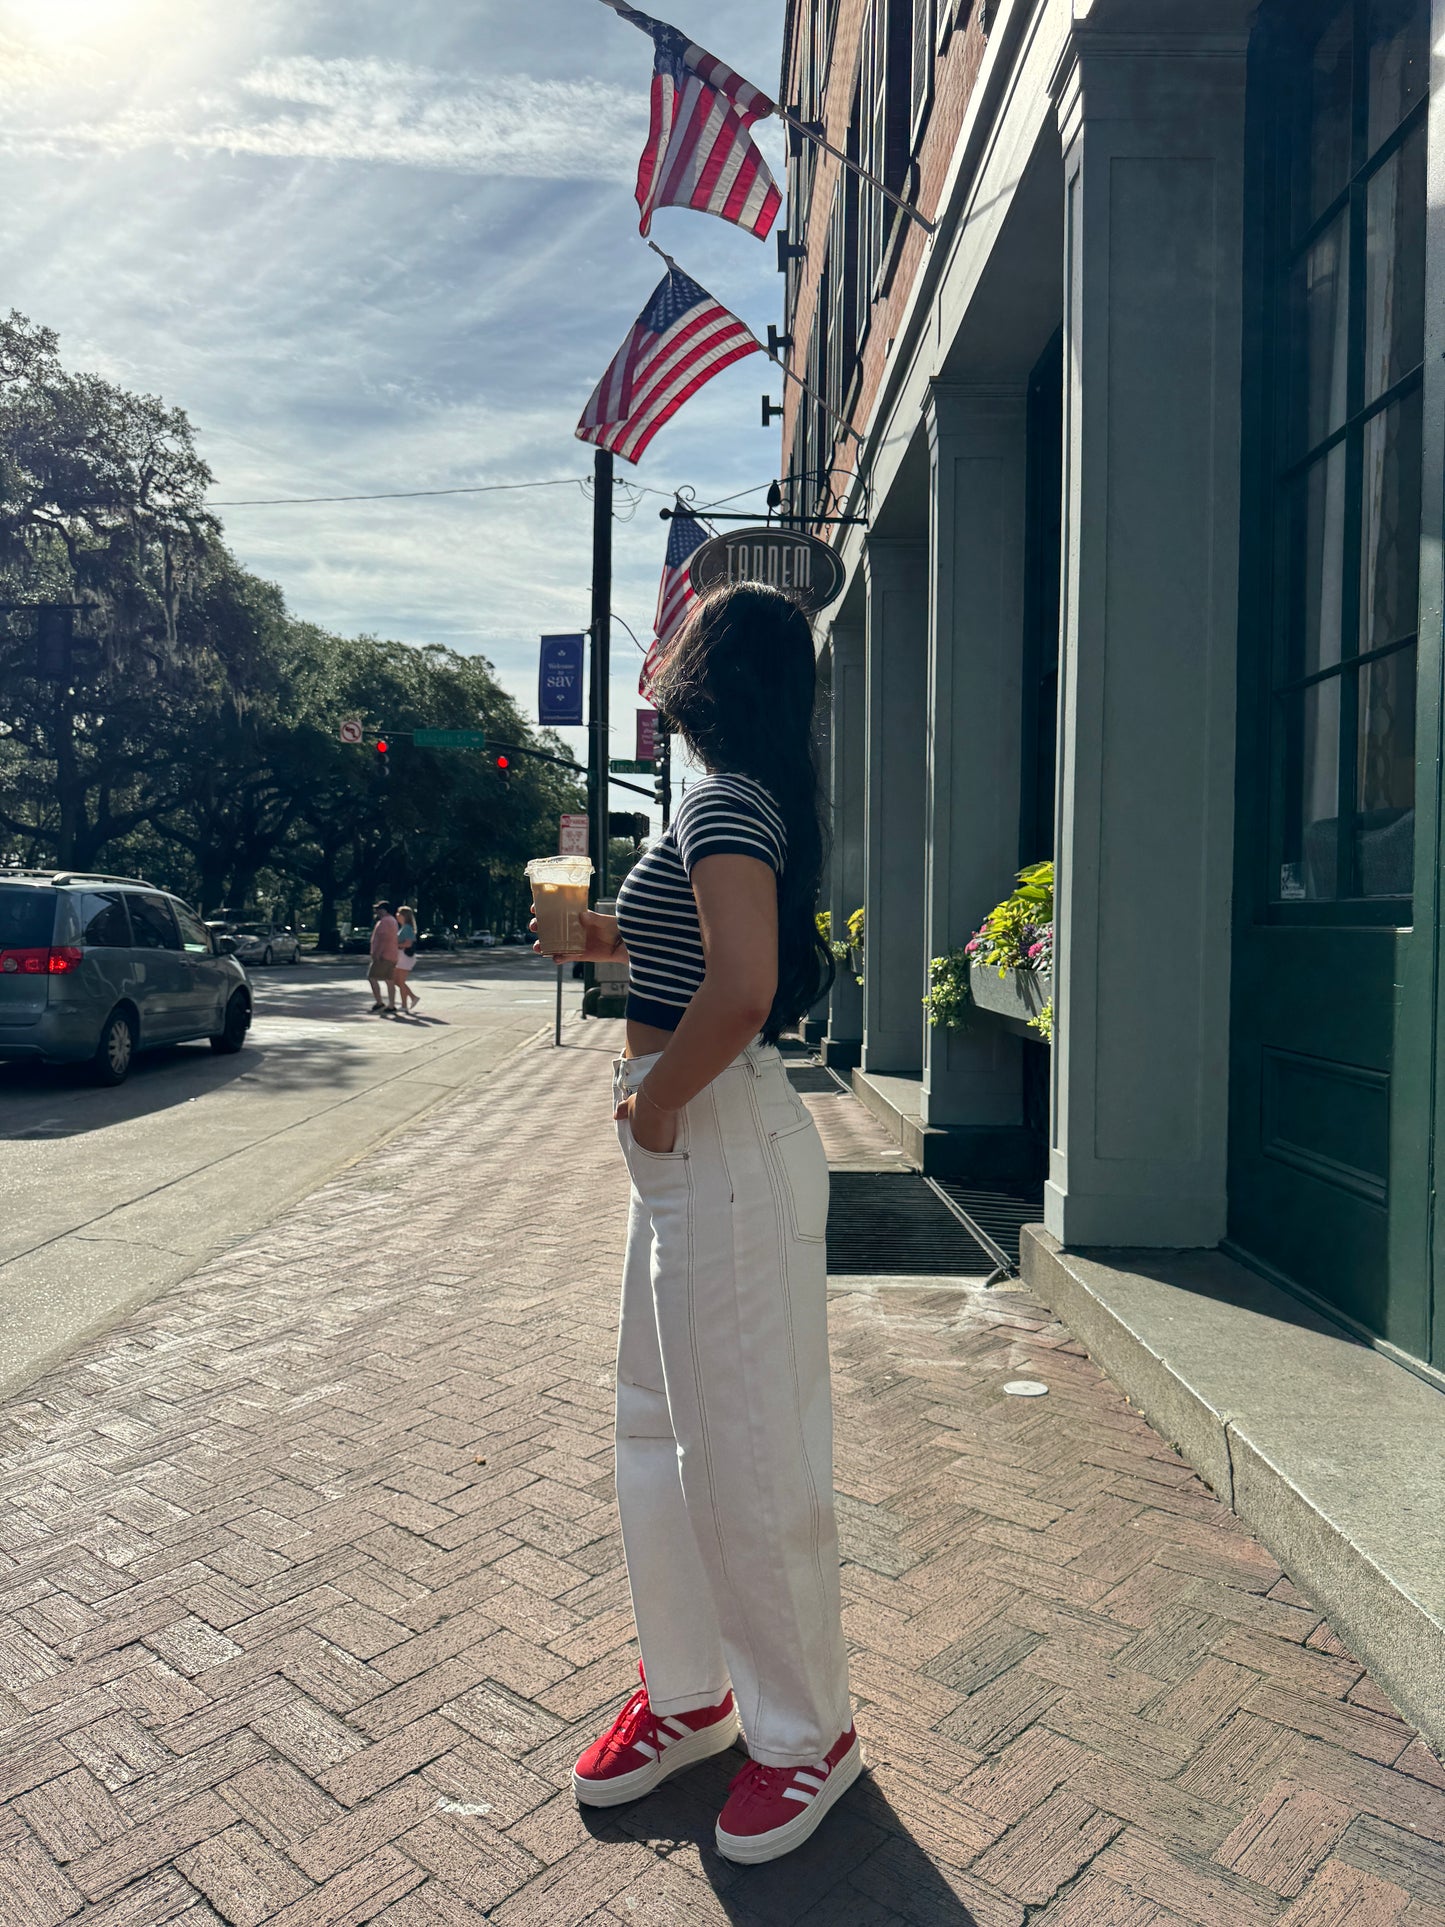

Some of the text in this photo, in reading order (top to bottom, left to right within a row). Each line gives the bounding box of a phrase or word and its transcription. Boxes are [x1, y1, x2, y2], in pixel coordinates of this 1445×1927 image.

[725, 545, 810, 588] TANDEM
[547, 676, 575, 687] sav
[611, 760, 641, 773] Lincoln
